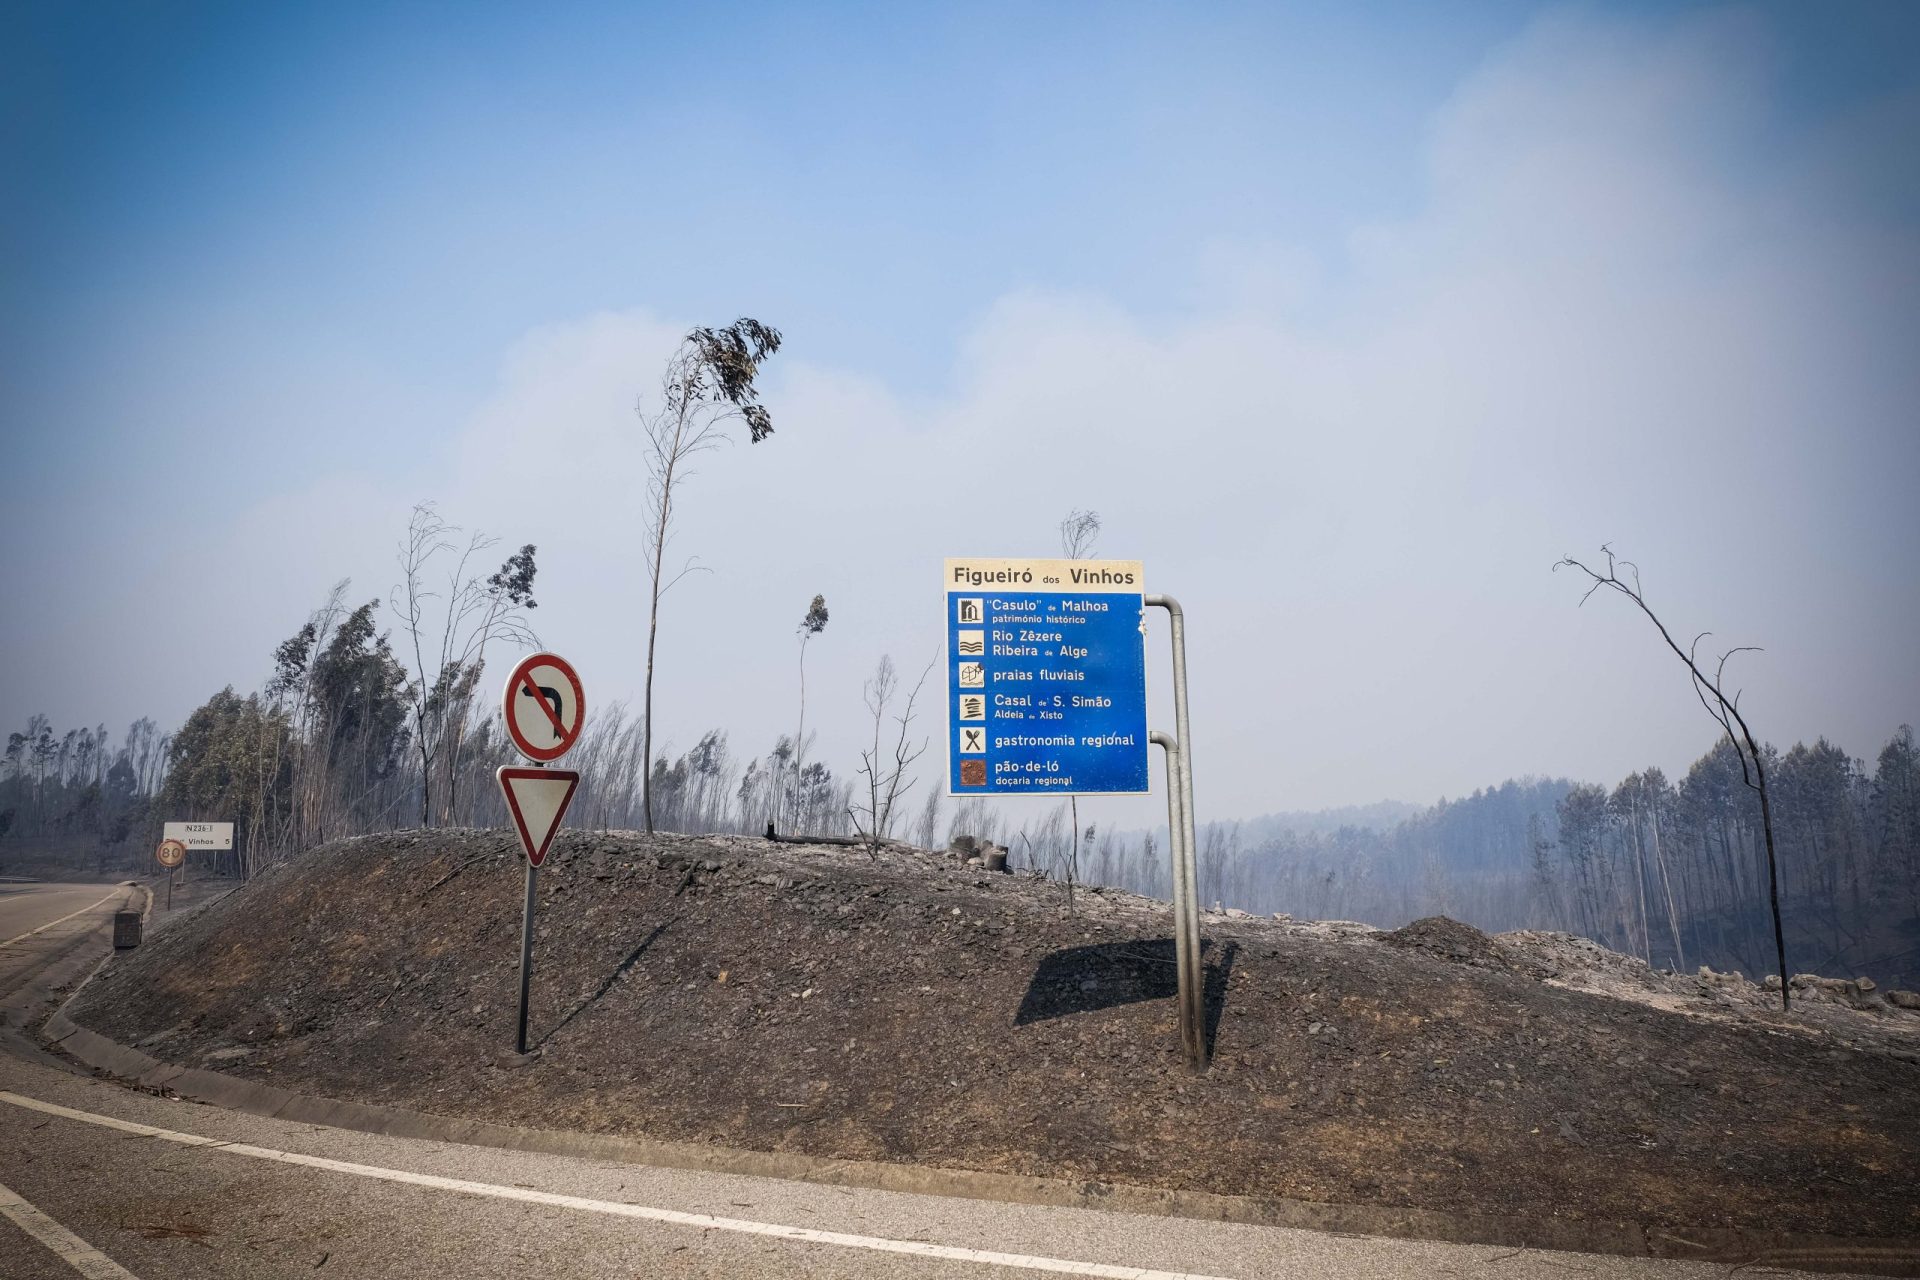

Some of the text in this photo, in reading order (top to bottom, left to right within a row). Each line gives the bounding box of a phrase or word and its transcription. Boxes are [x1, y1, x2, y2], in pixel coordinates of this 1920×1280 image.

[954, 567, 1134, 586] Figueiró dos Vinhos
[1062, 600, 1109, 612] Malhoa
[992, 614, 1086, 624] património histórico
[992, 630, 1062, 642] Rio Zêzere
[993, 645, 1038, 656] Ribeira
[1060, 645, 1088, 658] Alge
[993, 669, 1085, 683] praias fluviais
[994, 694, 1032, 706] Casal
[1053, 695, 1065, 707] S.
[1071, 695, 1112, 708] Simão
[994, 710, 1024, 719] Aldeia
[1039, 711, 1063, 720] Xisto
[995, 734, 1135, 748] gastronomia regional
[995, 760, 1059, 774] pão-de-ló
[995, 776, 1073, 787] doçaria regional
[162, 847, 181, 858] 80
